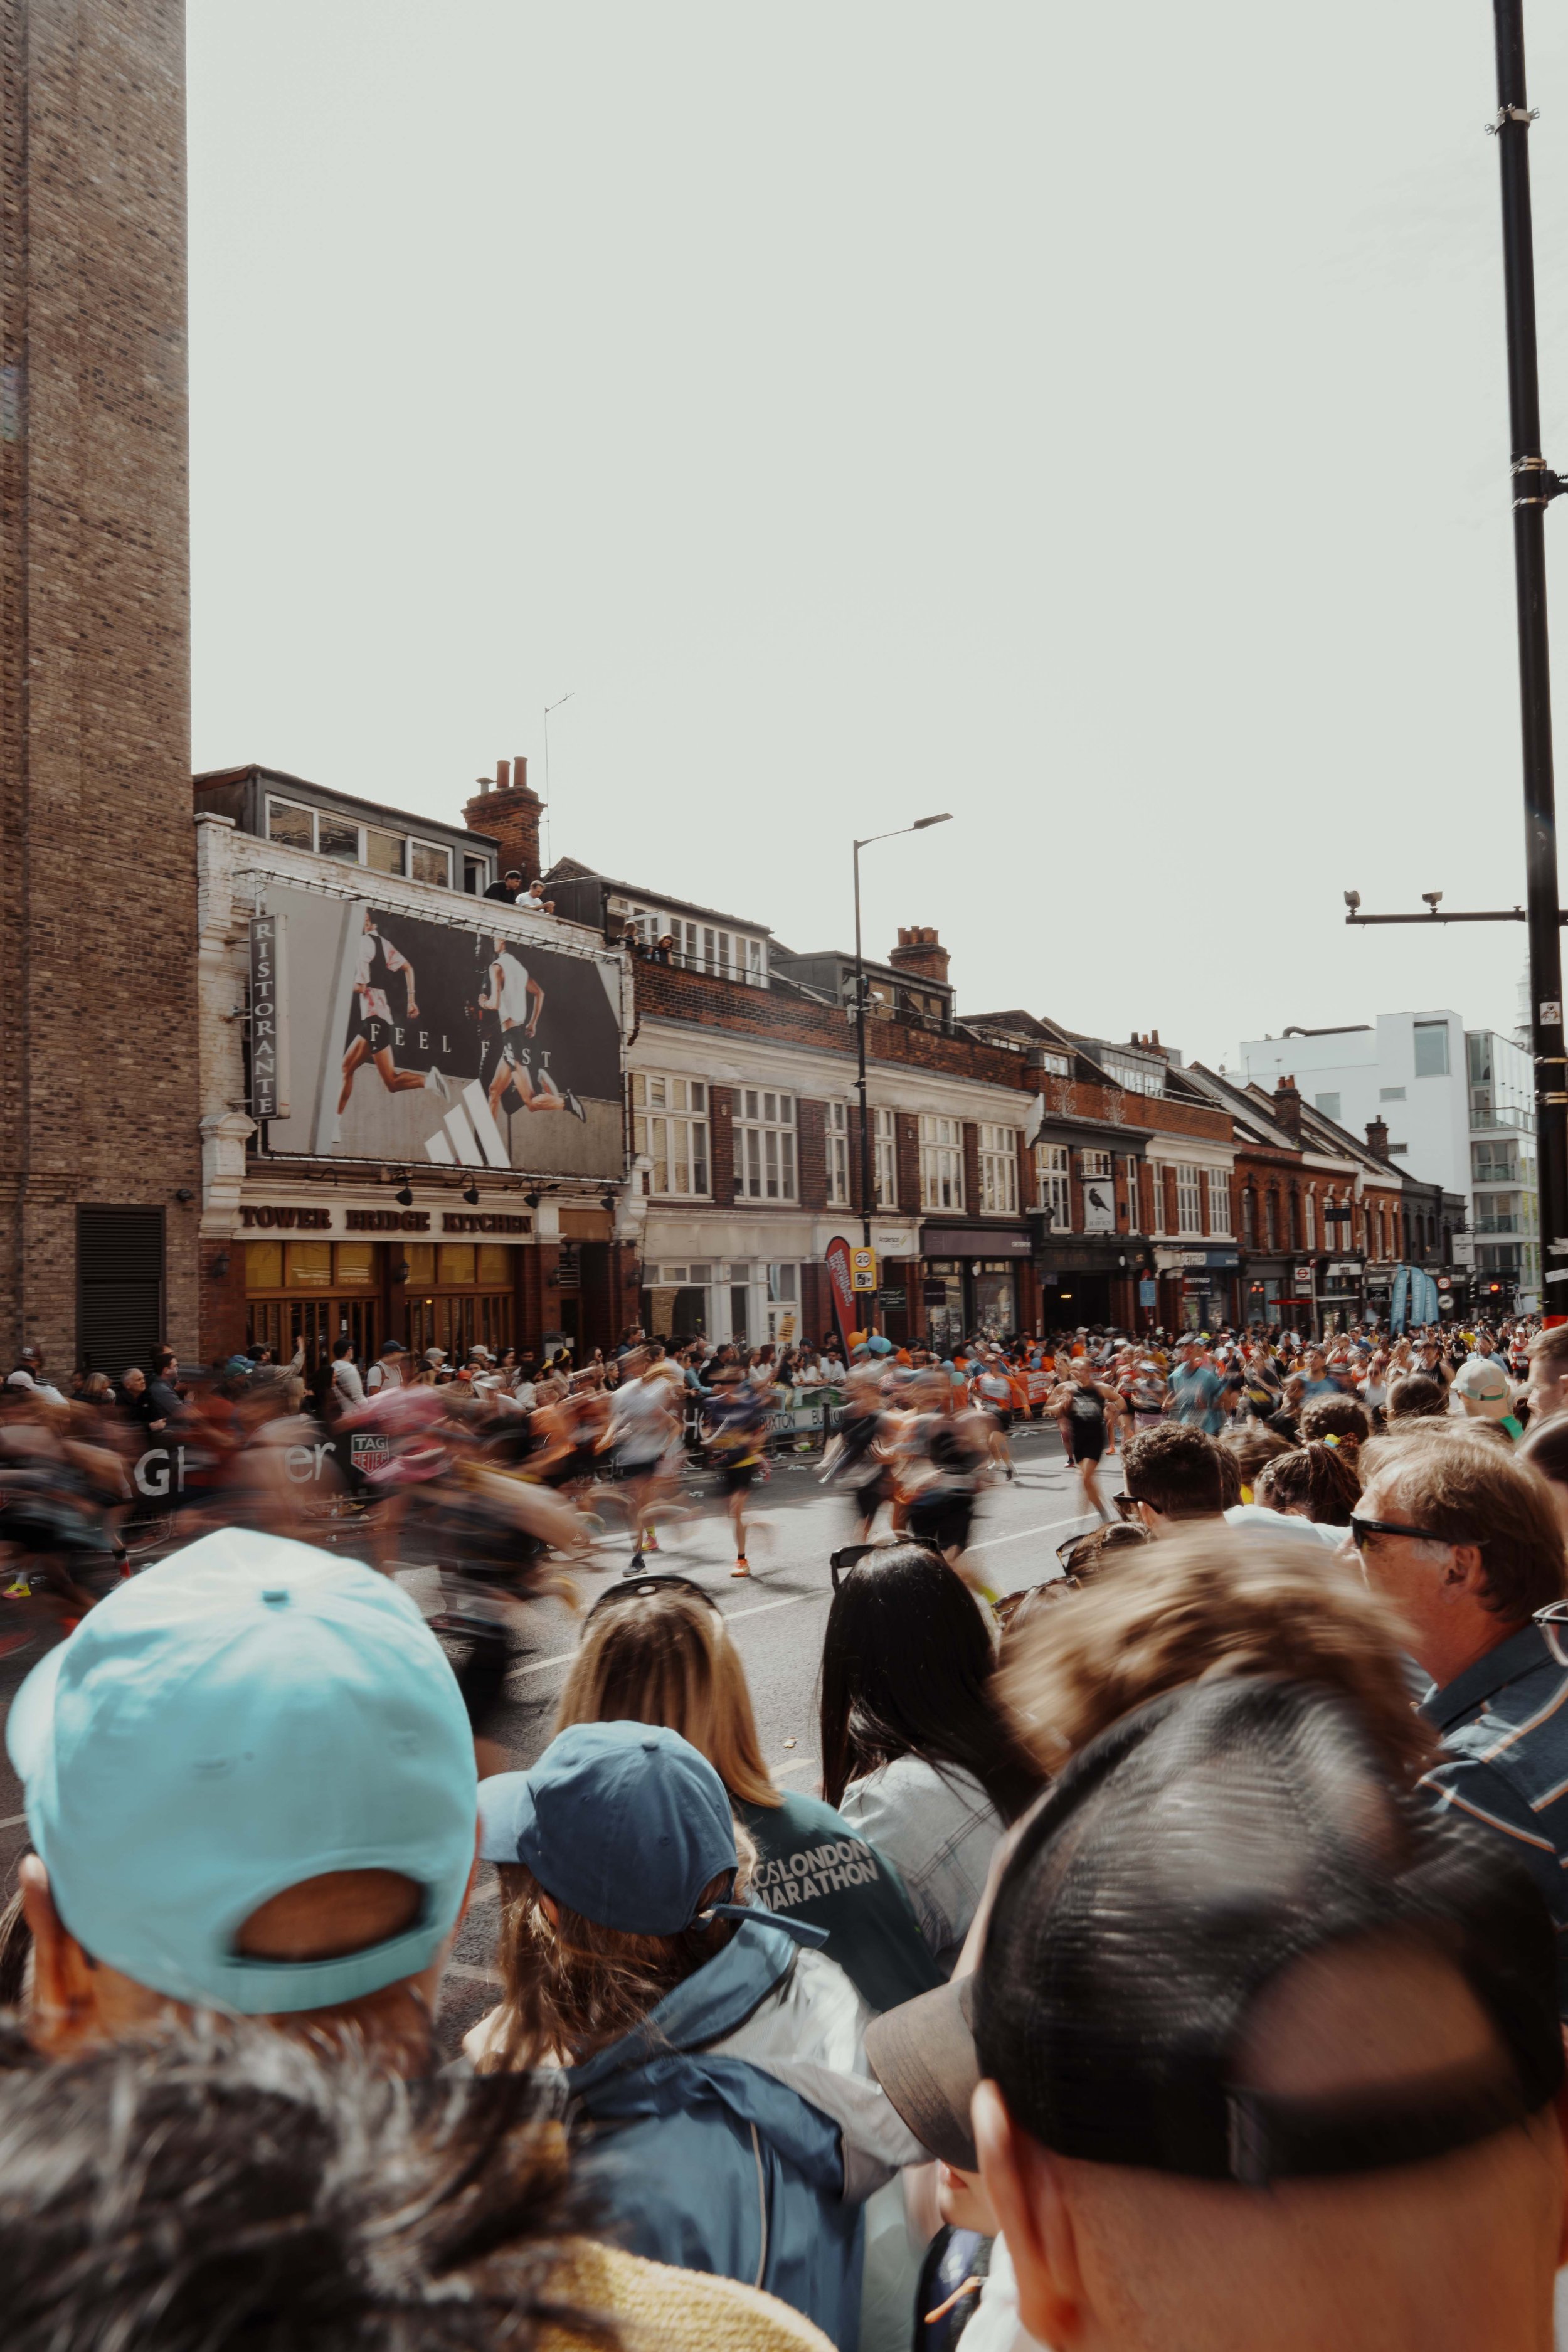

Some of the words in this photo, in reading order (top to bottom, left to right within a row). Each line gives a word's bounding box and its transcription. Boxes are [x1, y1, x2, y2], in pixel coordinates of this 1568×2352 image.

[254, 923, 277, 1114] RISTORANTE
[370, 1023, 452, 1053] FEEL
[480, 1041, 551, 1067] FAST
[239, 1205, 332, 1229] TOWER
[346, 1209, 431, 1231] BRIDGE
[442, 1212, 532, 1234] KITCHEN
[758, 1412, 796, 1431] BUXTON
[354, 1437, 386, 1449] TAG
[354, 1452, 388, 1471] HEUER
[776, 1838, 872, 1882] LONDON
